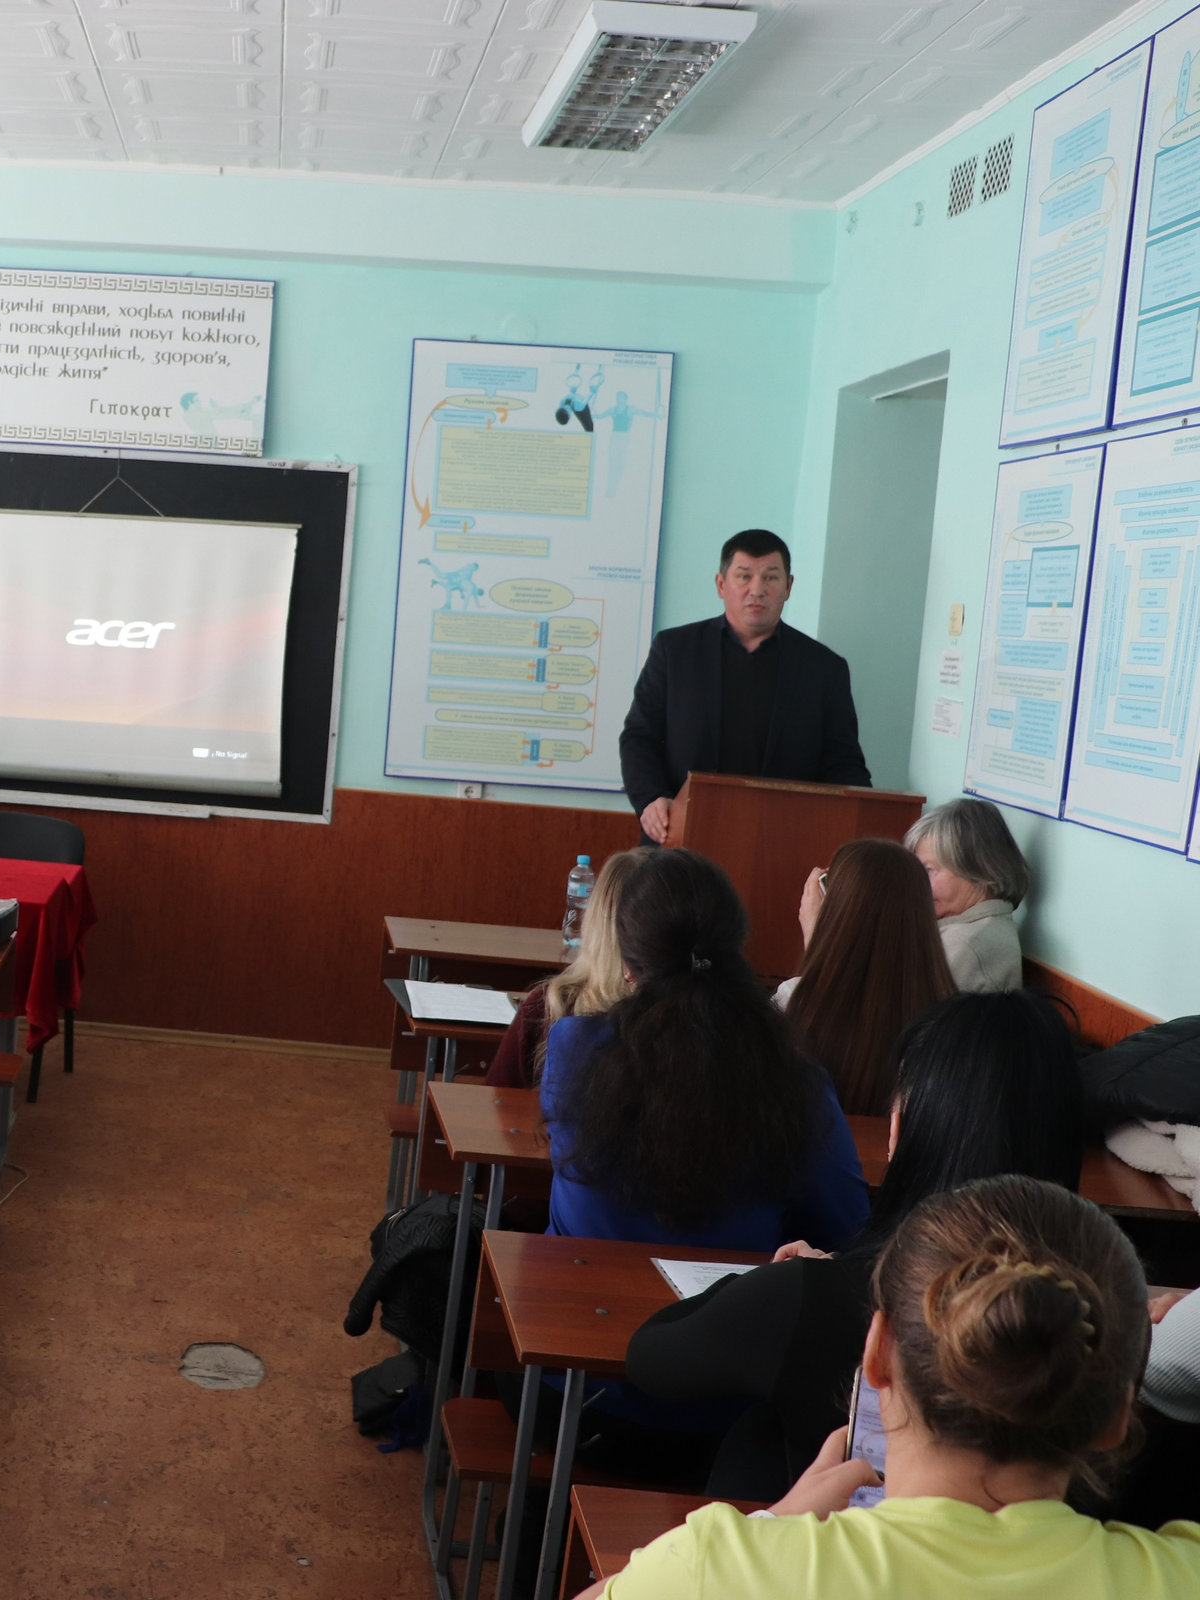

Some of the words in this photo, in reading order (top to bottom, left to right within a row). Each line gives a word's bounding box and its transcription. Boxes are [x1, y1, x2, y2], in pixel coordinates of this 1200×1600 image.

[52, 303, 110, 318] вправи,
[119, 303, 174, 321] ходьба
[182, 307, 245, 323] повинні
[9, 320, 121, 338] повсякденний
[130, 328, 174, 343] побут
[182, 326, 261, 347] кожного,
[28, 343, 145, 362] працездатність,
[65, 618, 176, 650] acer
